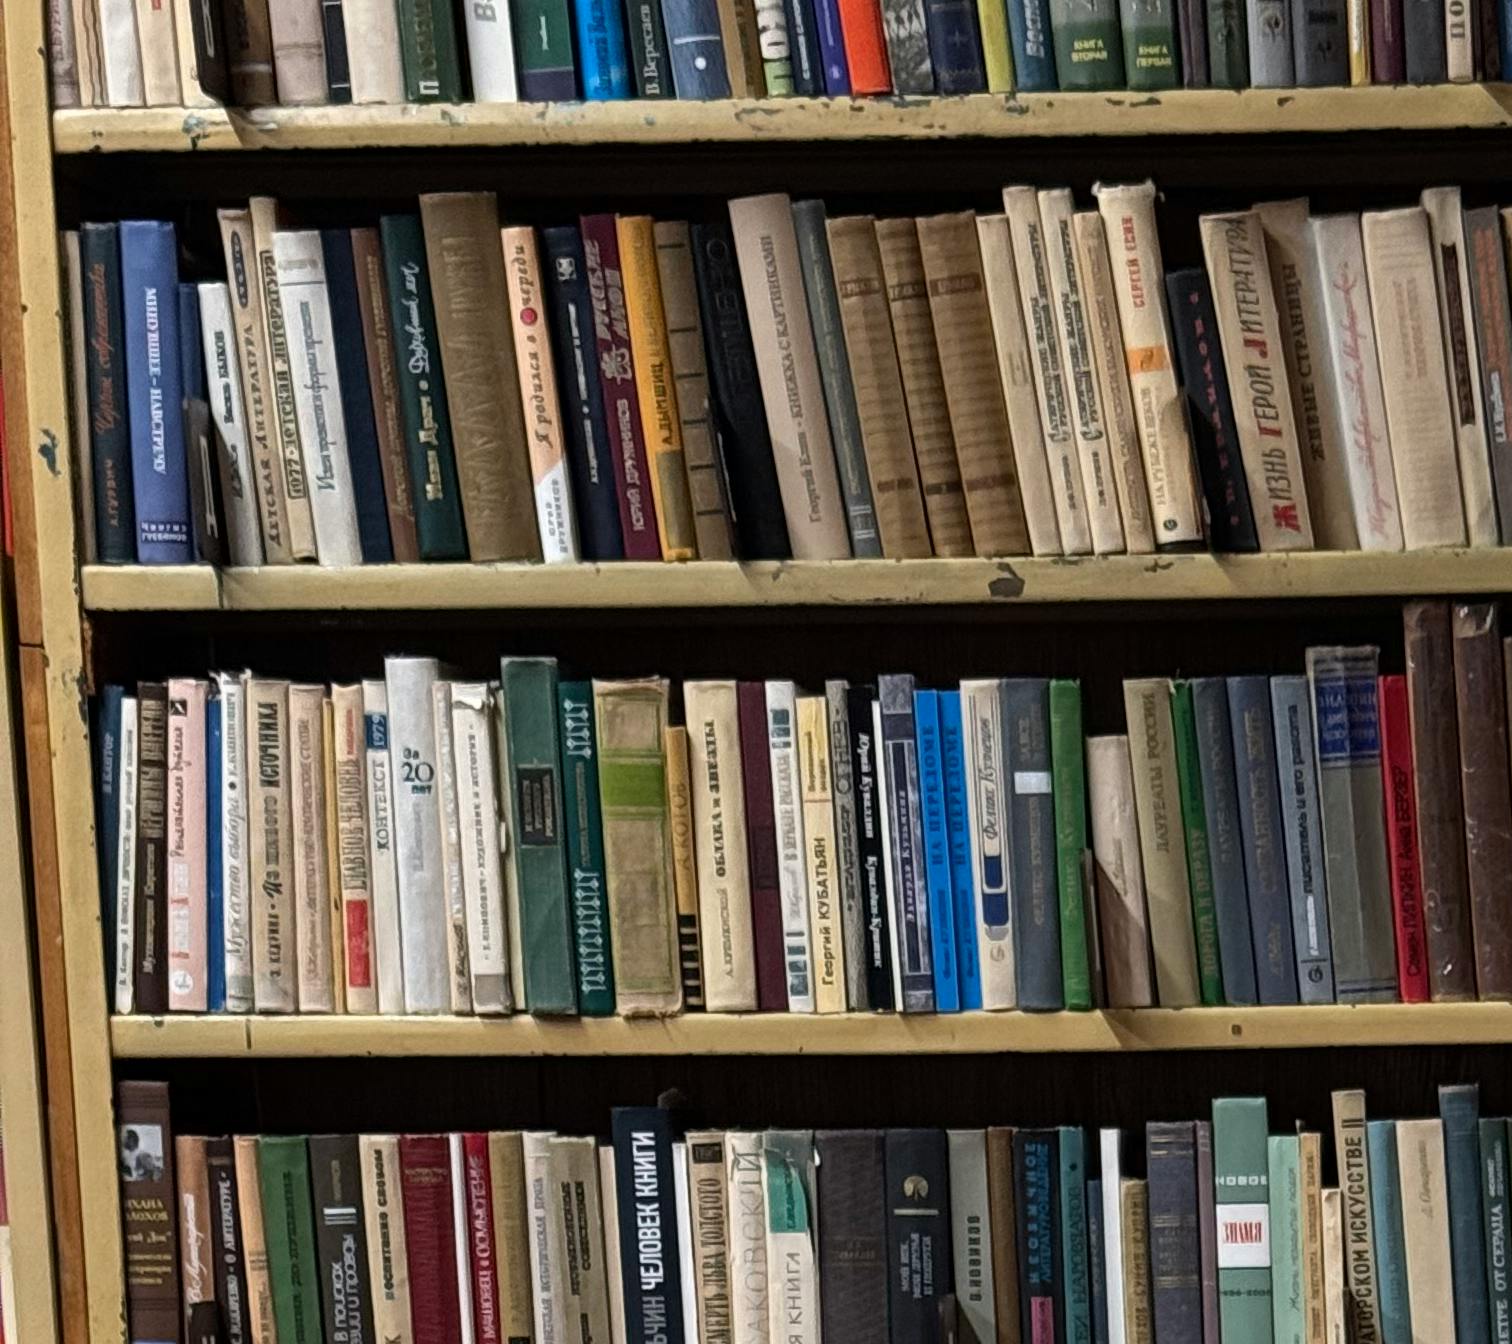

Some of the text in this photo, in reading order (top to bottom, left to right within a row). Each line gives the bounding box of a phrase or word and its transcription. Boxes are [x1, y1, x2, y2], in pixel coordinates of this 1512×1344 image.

[760, 235, 789, 337] КАРТИНКАМИ
[1127, 257, 1145, 307] СЕРГЕЙ
[1282, 263, 1311, 376] СТРАНИЦЫ
[1226, 216, 1301, 533] ЖИЗНЬ ГЕРОЙ ЛИТЕРАТУРА
[371, 759, 390, 851] КОНТЕКСТ
[402, 761, 434, 783] 20
[1143, 692, 1170, 853] ЛАУРЕАТЫ РОССИИ
[812, 836, 835, 985] Георгий КУБАТЬЯН
[631, 1131, 658, 1197] КНИГИ
[1342, 1135, 1368, 1244] ИСКУССТВЕ
[637, 1202, 664, 1290] ЧЕЛОВЕК
[697, 1177, 725, 1247] ТОЛСТОГО
[1490, 1203, 1505, 1268] СЕРДЦА
[701, 1251, 726, 1289] ЛЬВА
[1493, 1270, 1505, 1291] ОТ
